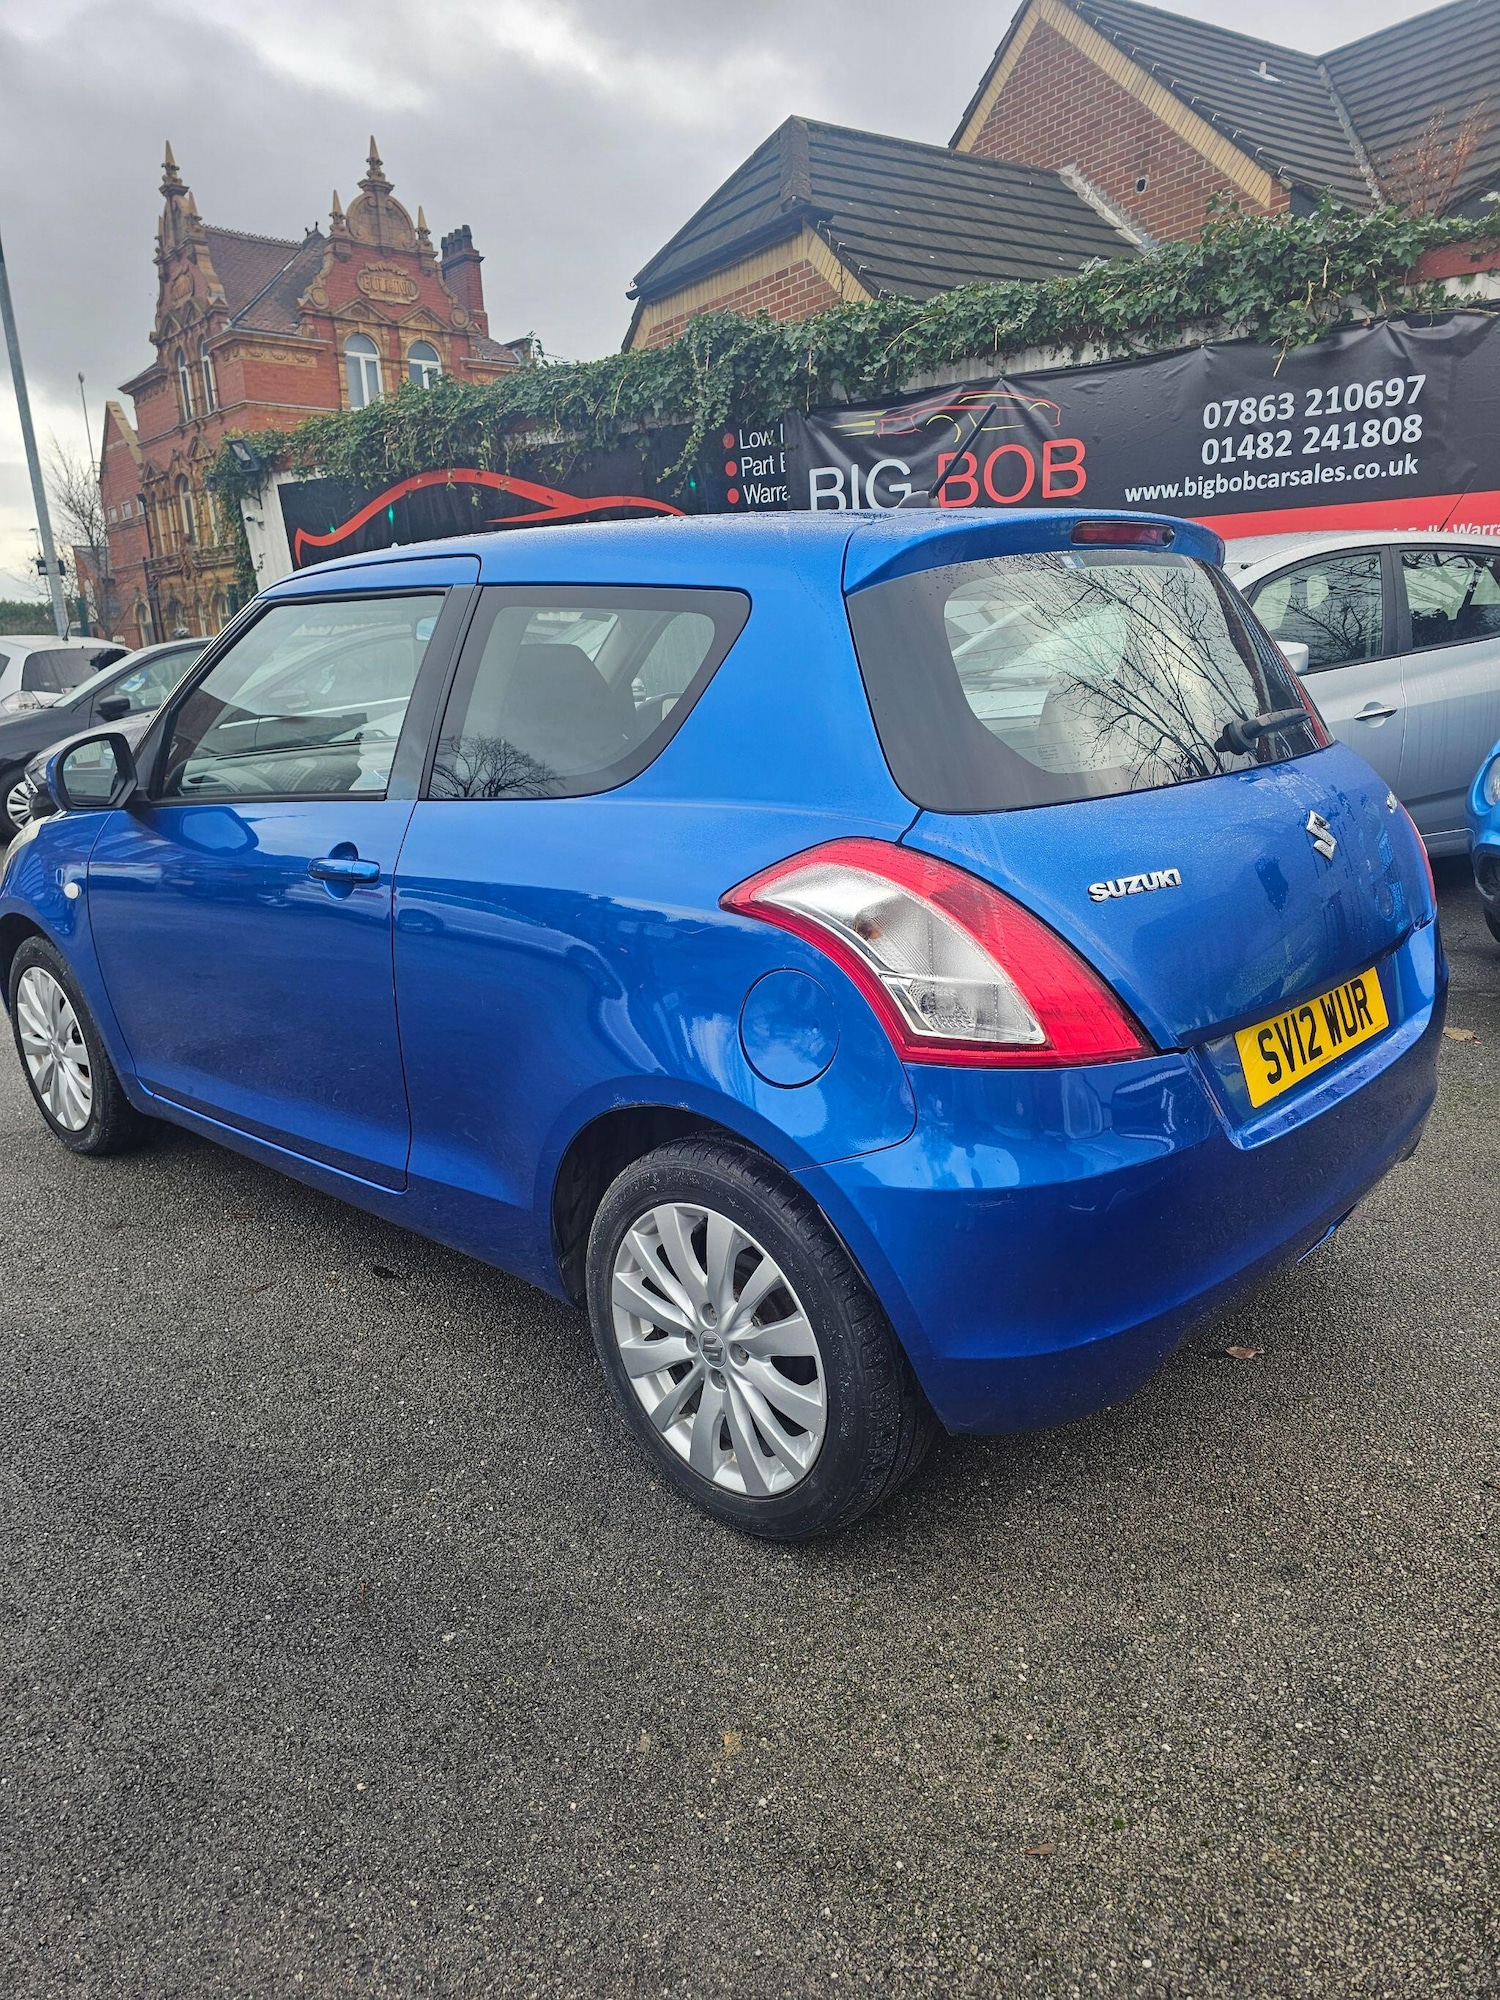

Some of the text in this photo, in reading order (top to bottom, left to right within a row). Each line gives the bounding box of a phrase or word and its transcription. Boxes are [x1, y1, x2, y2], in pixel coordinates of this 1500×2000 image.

[1203, 374, 1426, 429] 07863 210697
[739, 428, 774, 449] Low
[1201, 414, 1423, 465] 01482 241808
[741, 455, 775, 478] Part
[809, 438, 1087, 511] BIG BOB
[1124, 453, 1419, 502] www.bigbobcarsales.co.uk
[1088, 868, 1182, 903] SUZUKI
[1257, 978, 1373, 1085] SV12 WUR
